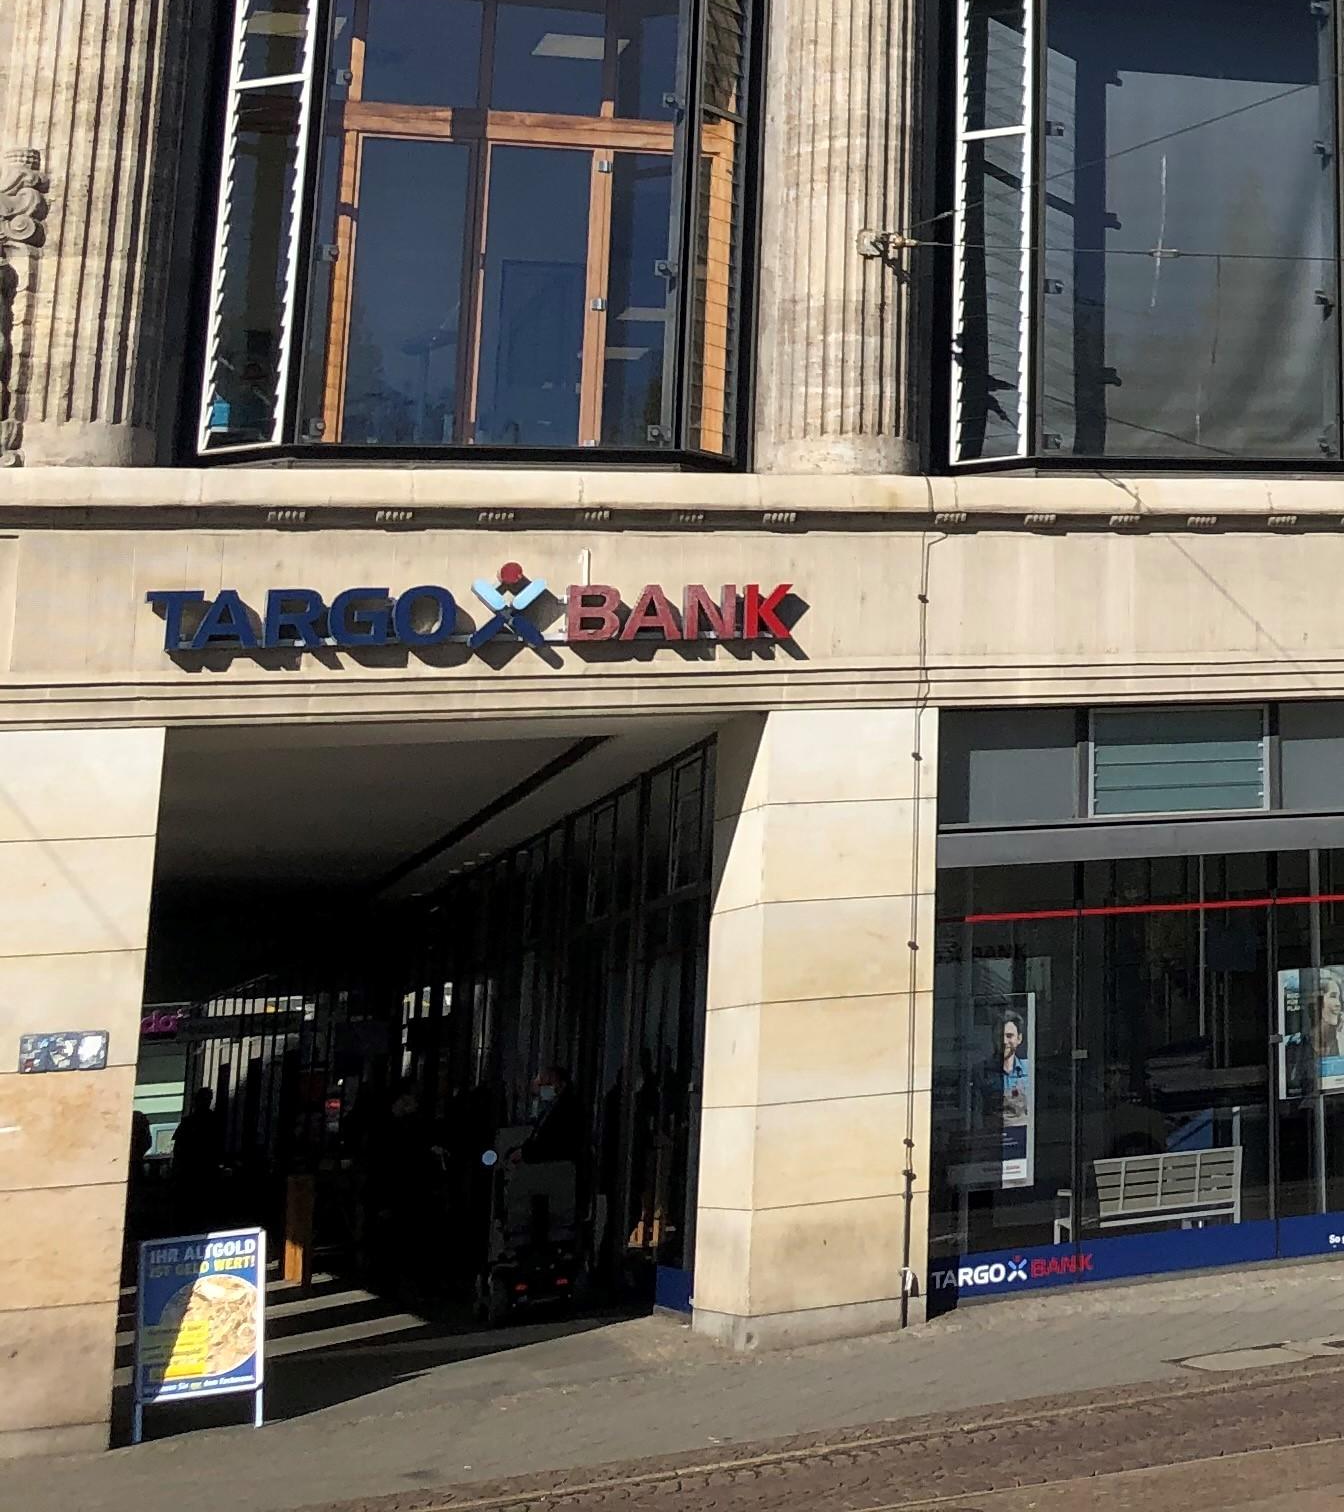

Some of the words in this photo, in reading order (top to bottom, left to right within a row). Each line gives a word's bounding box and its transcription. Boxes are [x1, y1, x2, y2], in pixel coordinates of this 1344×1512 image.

[146, 585, 458, 652] TARGO
[566, 583, 794, 642] BANK
[1329, 1234, 1341, 1244] So
[150, 1247, 179, 1264] IHR
[213, 1255, 255, 1271] WERT!
